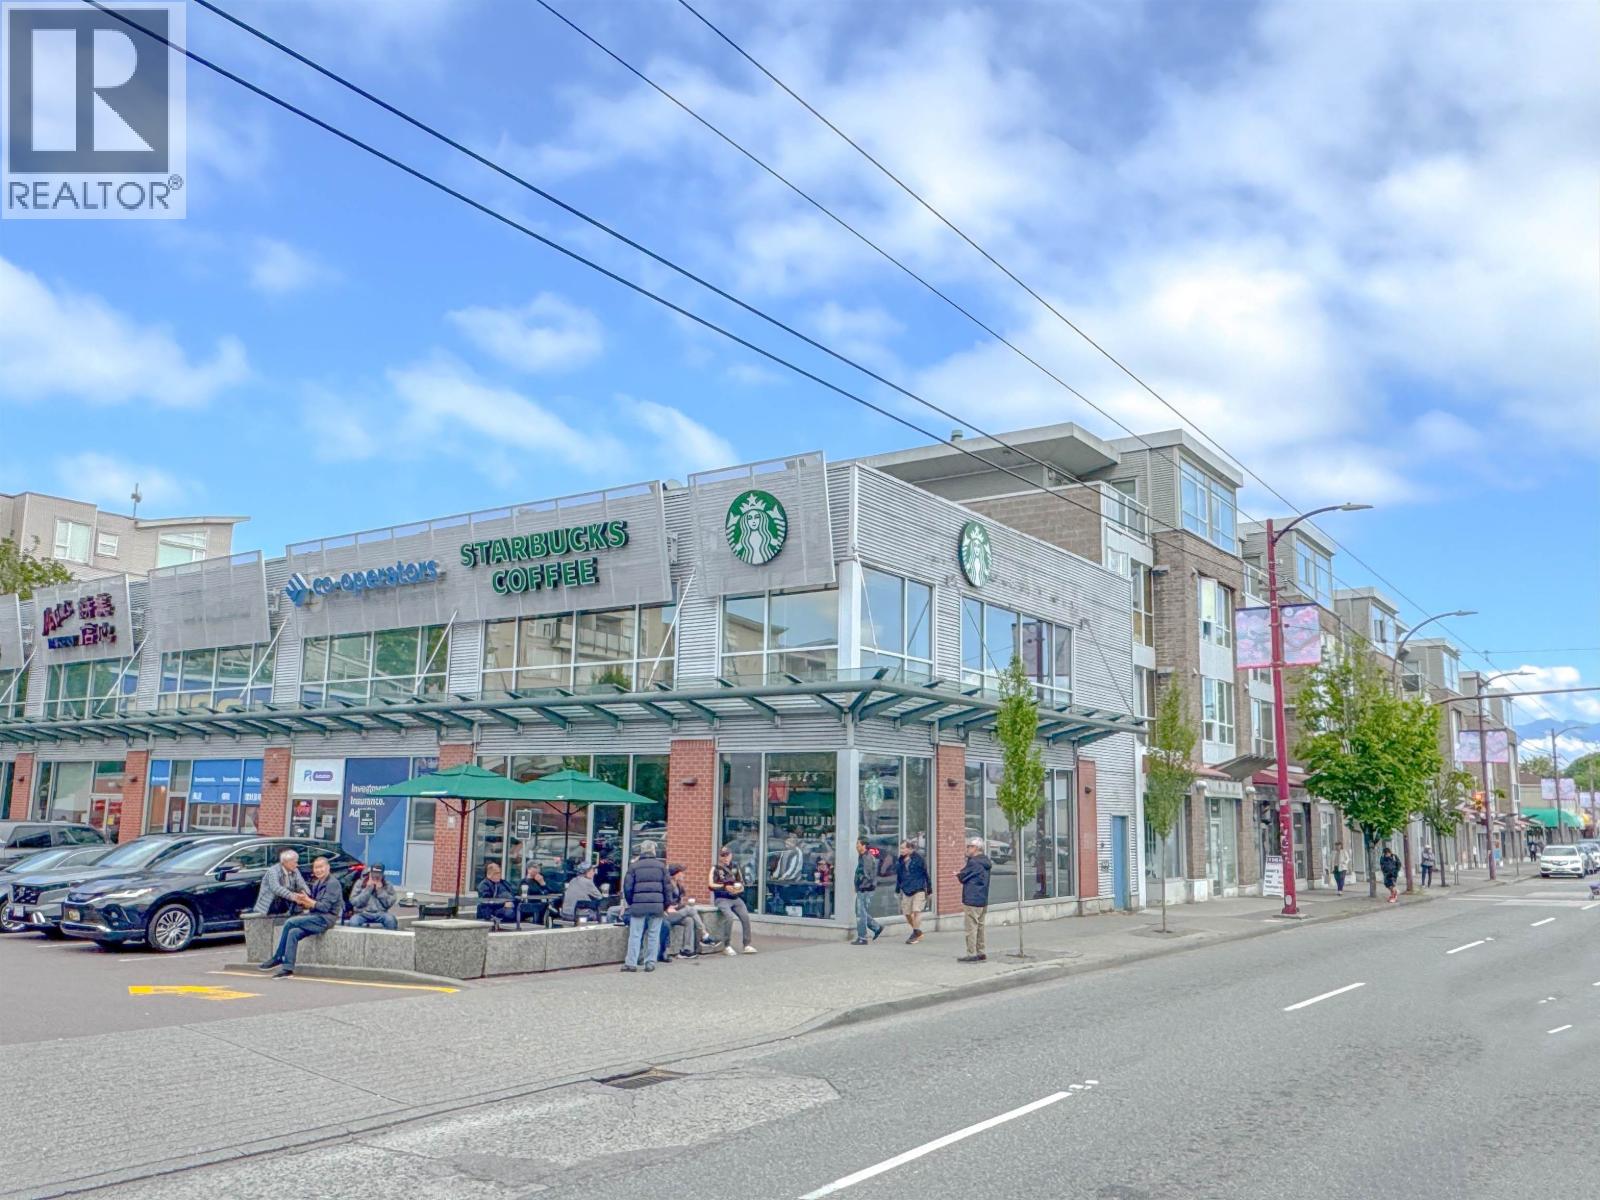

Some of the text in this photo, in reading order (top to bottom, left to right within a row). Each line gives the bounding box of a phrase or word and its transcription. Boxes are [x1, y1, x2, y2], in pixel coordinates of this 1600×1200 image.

[460, 520, 628, 568] STARBUCKS
[313, 561, 438, 596] co-operators
[491, 557, 600, 595] COFFEE
